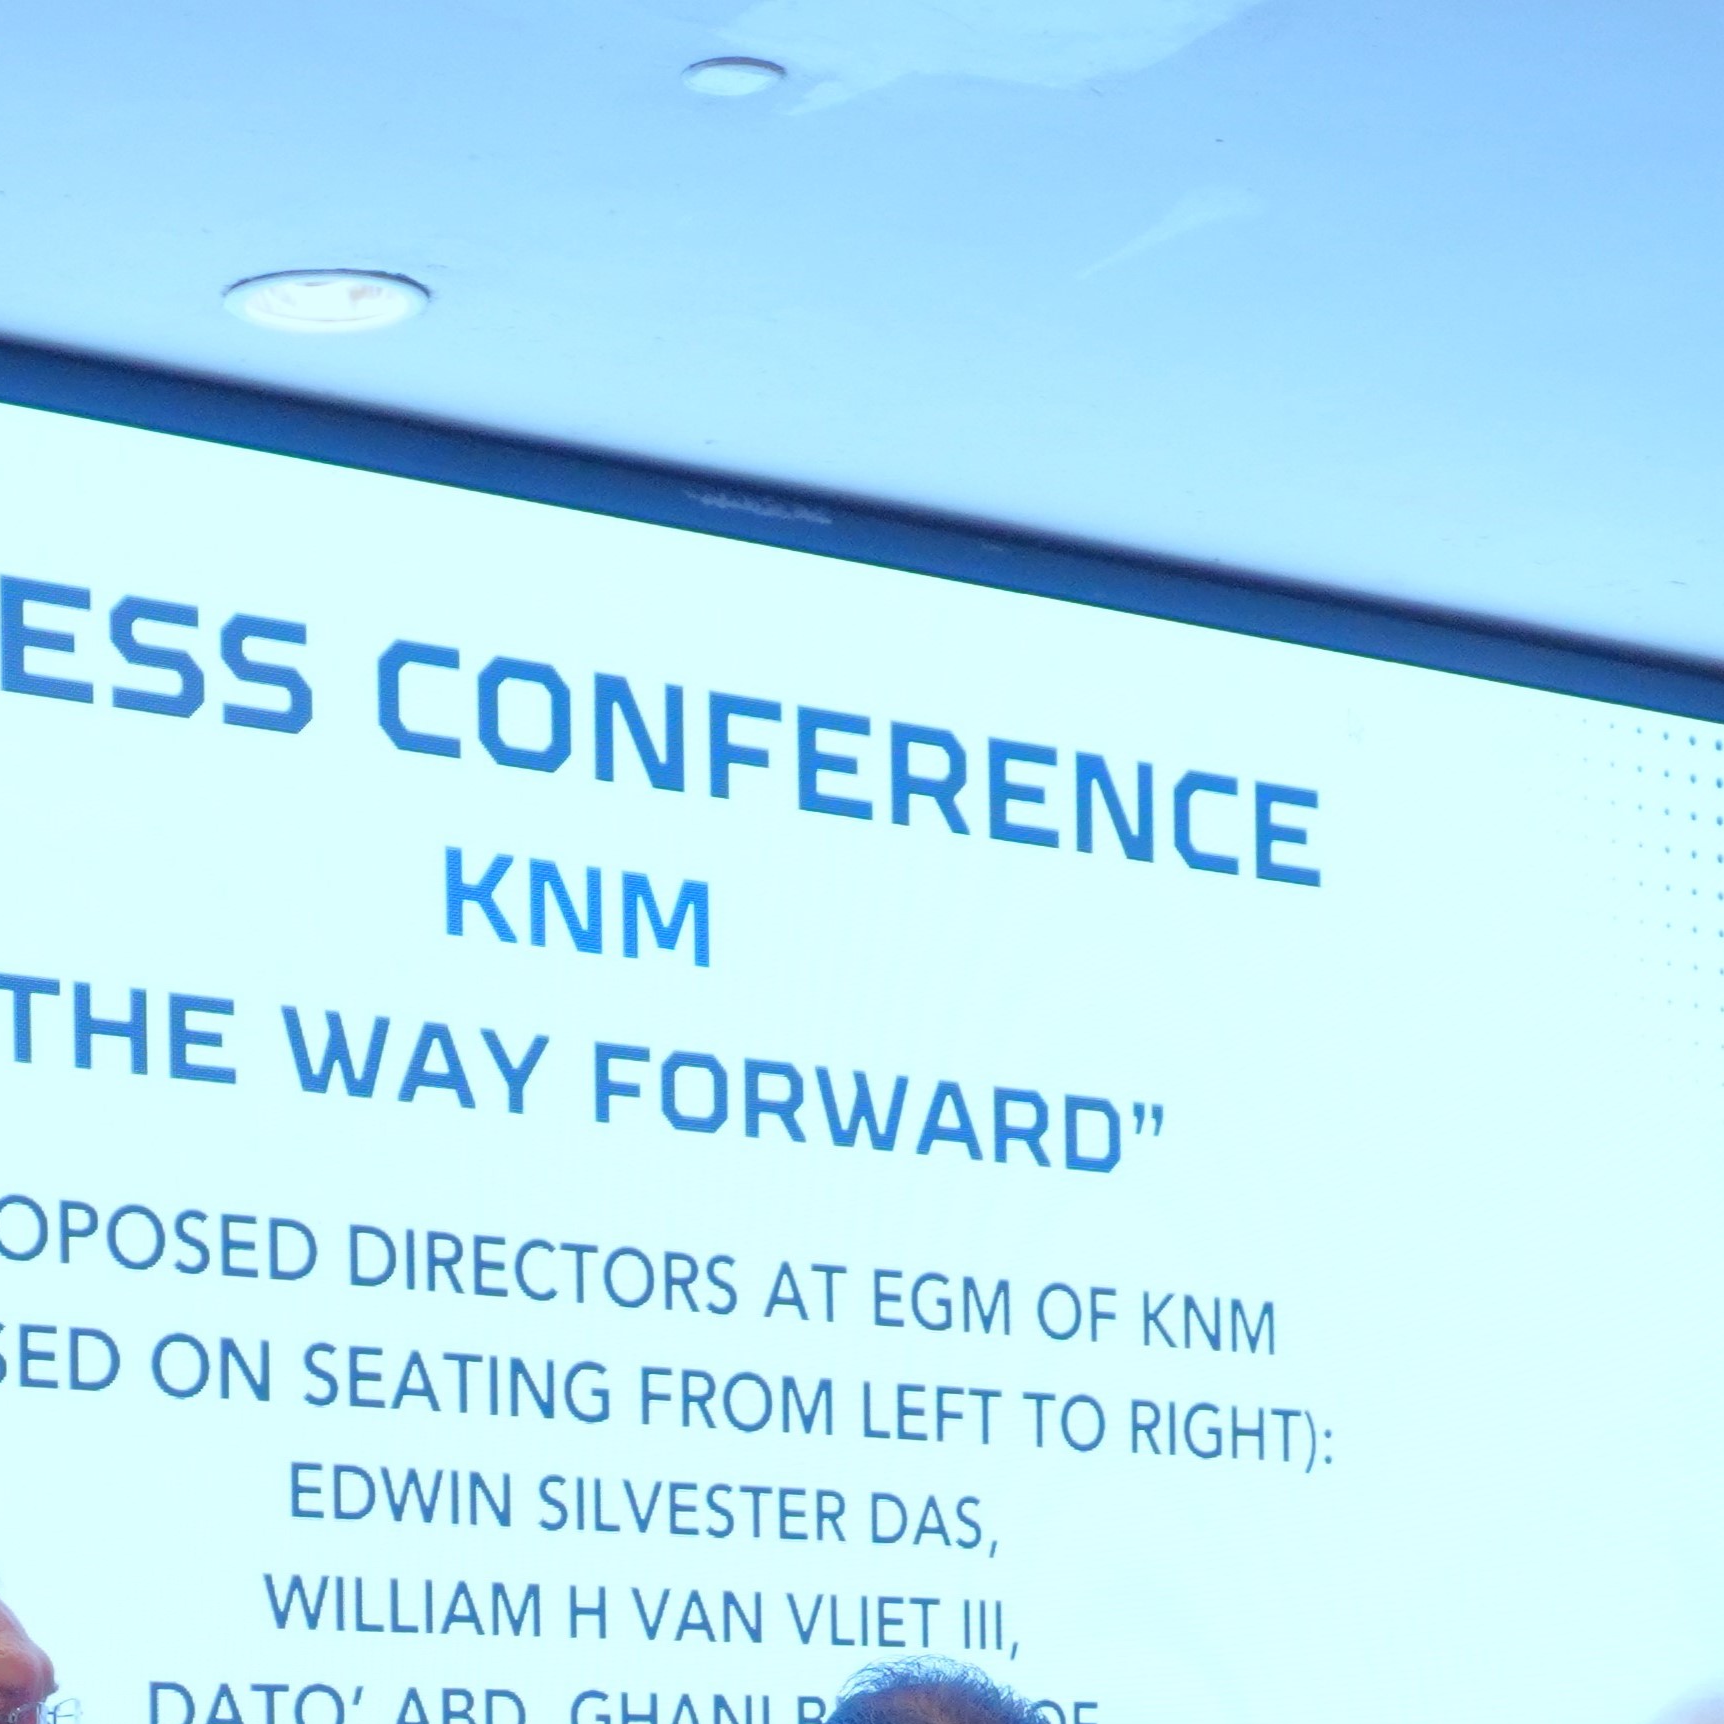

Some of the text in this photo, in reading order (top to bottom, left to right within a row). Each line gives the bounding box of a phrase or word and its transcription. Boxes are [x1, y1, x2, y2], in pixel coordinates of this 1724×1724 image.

[375, 637, 1323, 889] CONFERENCE
[443, 845, 712, 970] KNM
[279, 1003, 551, 1116] WAY
[592, 1039, 1165, 1175] FORWARD”
[347, 1222, 739, 1317] DIRECTORS
[762, 1259, 849, 1324] AT
[872, 1267, 1012, 1337] EGM
[1035, 1280, 1118, 1344] OF
[1141, 1289, 1276, 1357] KNM
[149, 1331, 272, 1403] ON
[301, 1340, 611, 1426] SEATING
[639, 1364, 835, 1437] FROM
[861, 1379, 1004, 1446] LEFT
[1021, 1390, 1107, 1455] TO
[1129, 1397, 1334, 1475] RIGHT):
[289, 1460, 999, 1560] EDWIN SILVESTER DAS,
[261, 1572, 1020, 1662] WILLIAM H VAN VLIET III,
